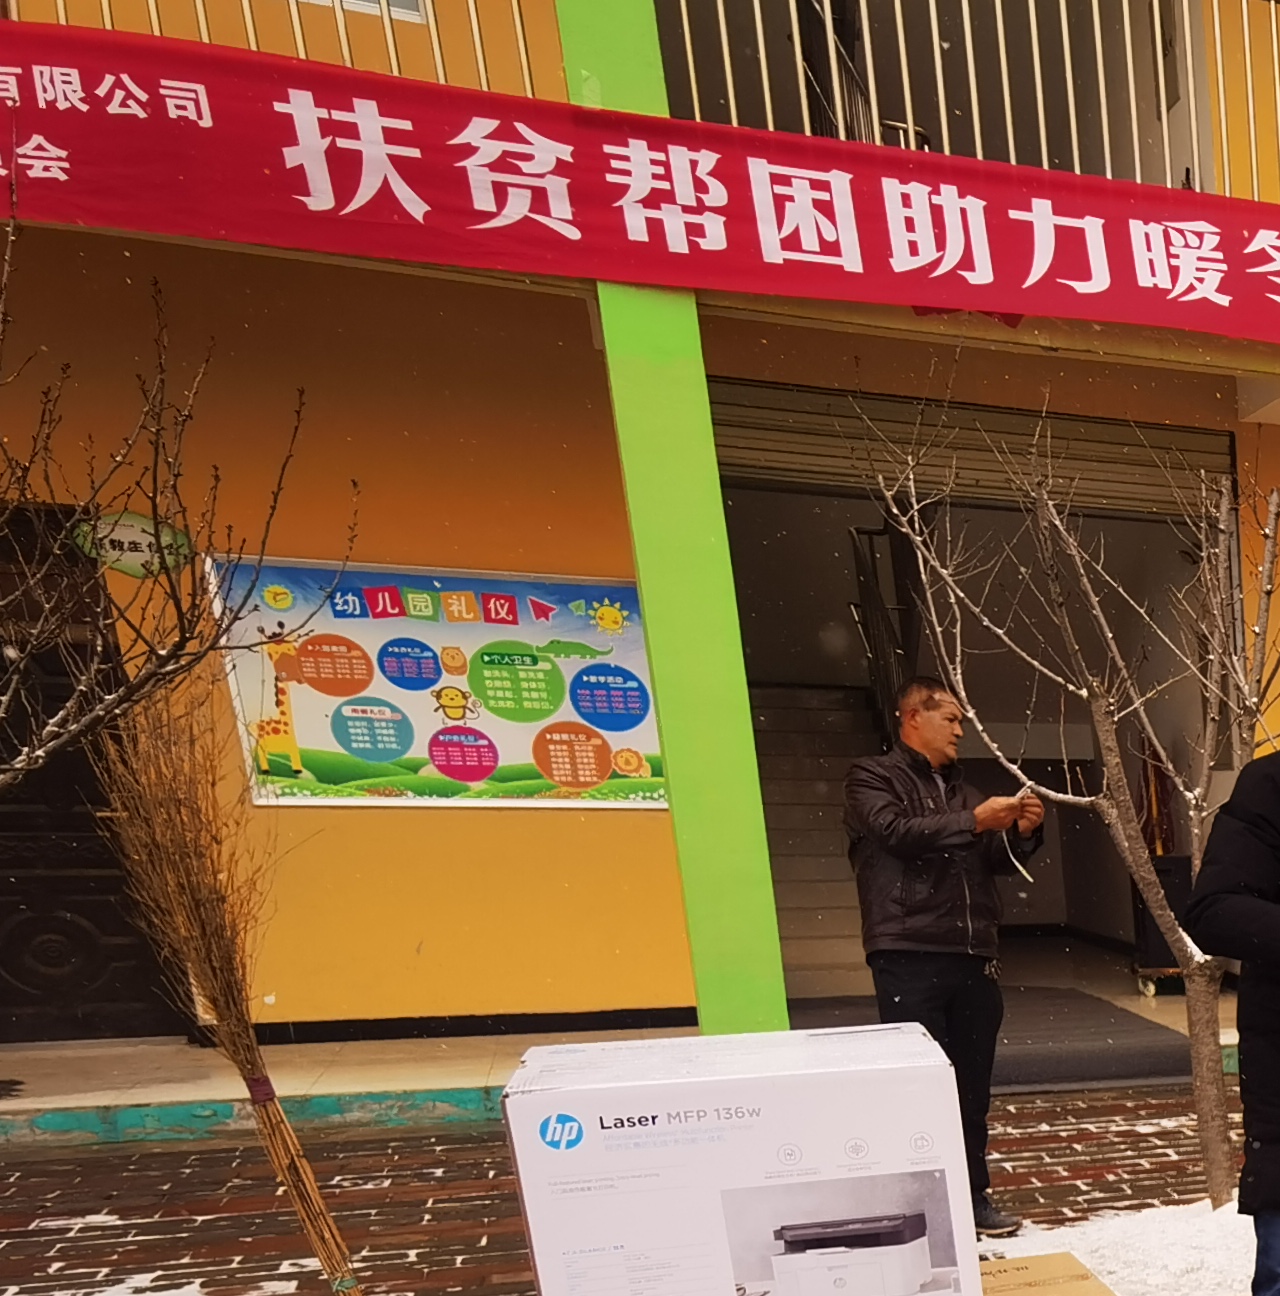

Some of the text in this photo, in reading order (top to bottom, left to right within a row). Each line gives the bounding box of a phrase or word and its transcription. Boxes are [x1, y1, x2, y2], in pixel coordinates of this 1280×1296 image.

[334, 590, 513, 621] 幼儿园礼仪
[490, 655, 534, 666] 个人卫生
[599, 1106, 763, 1130] Laser MFP 136w
[546, 1114, 579, 1150] hp
